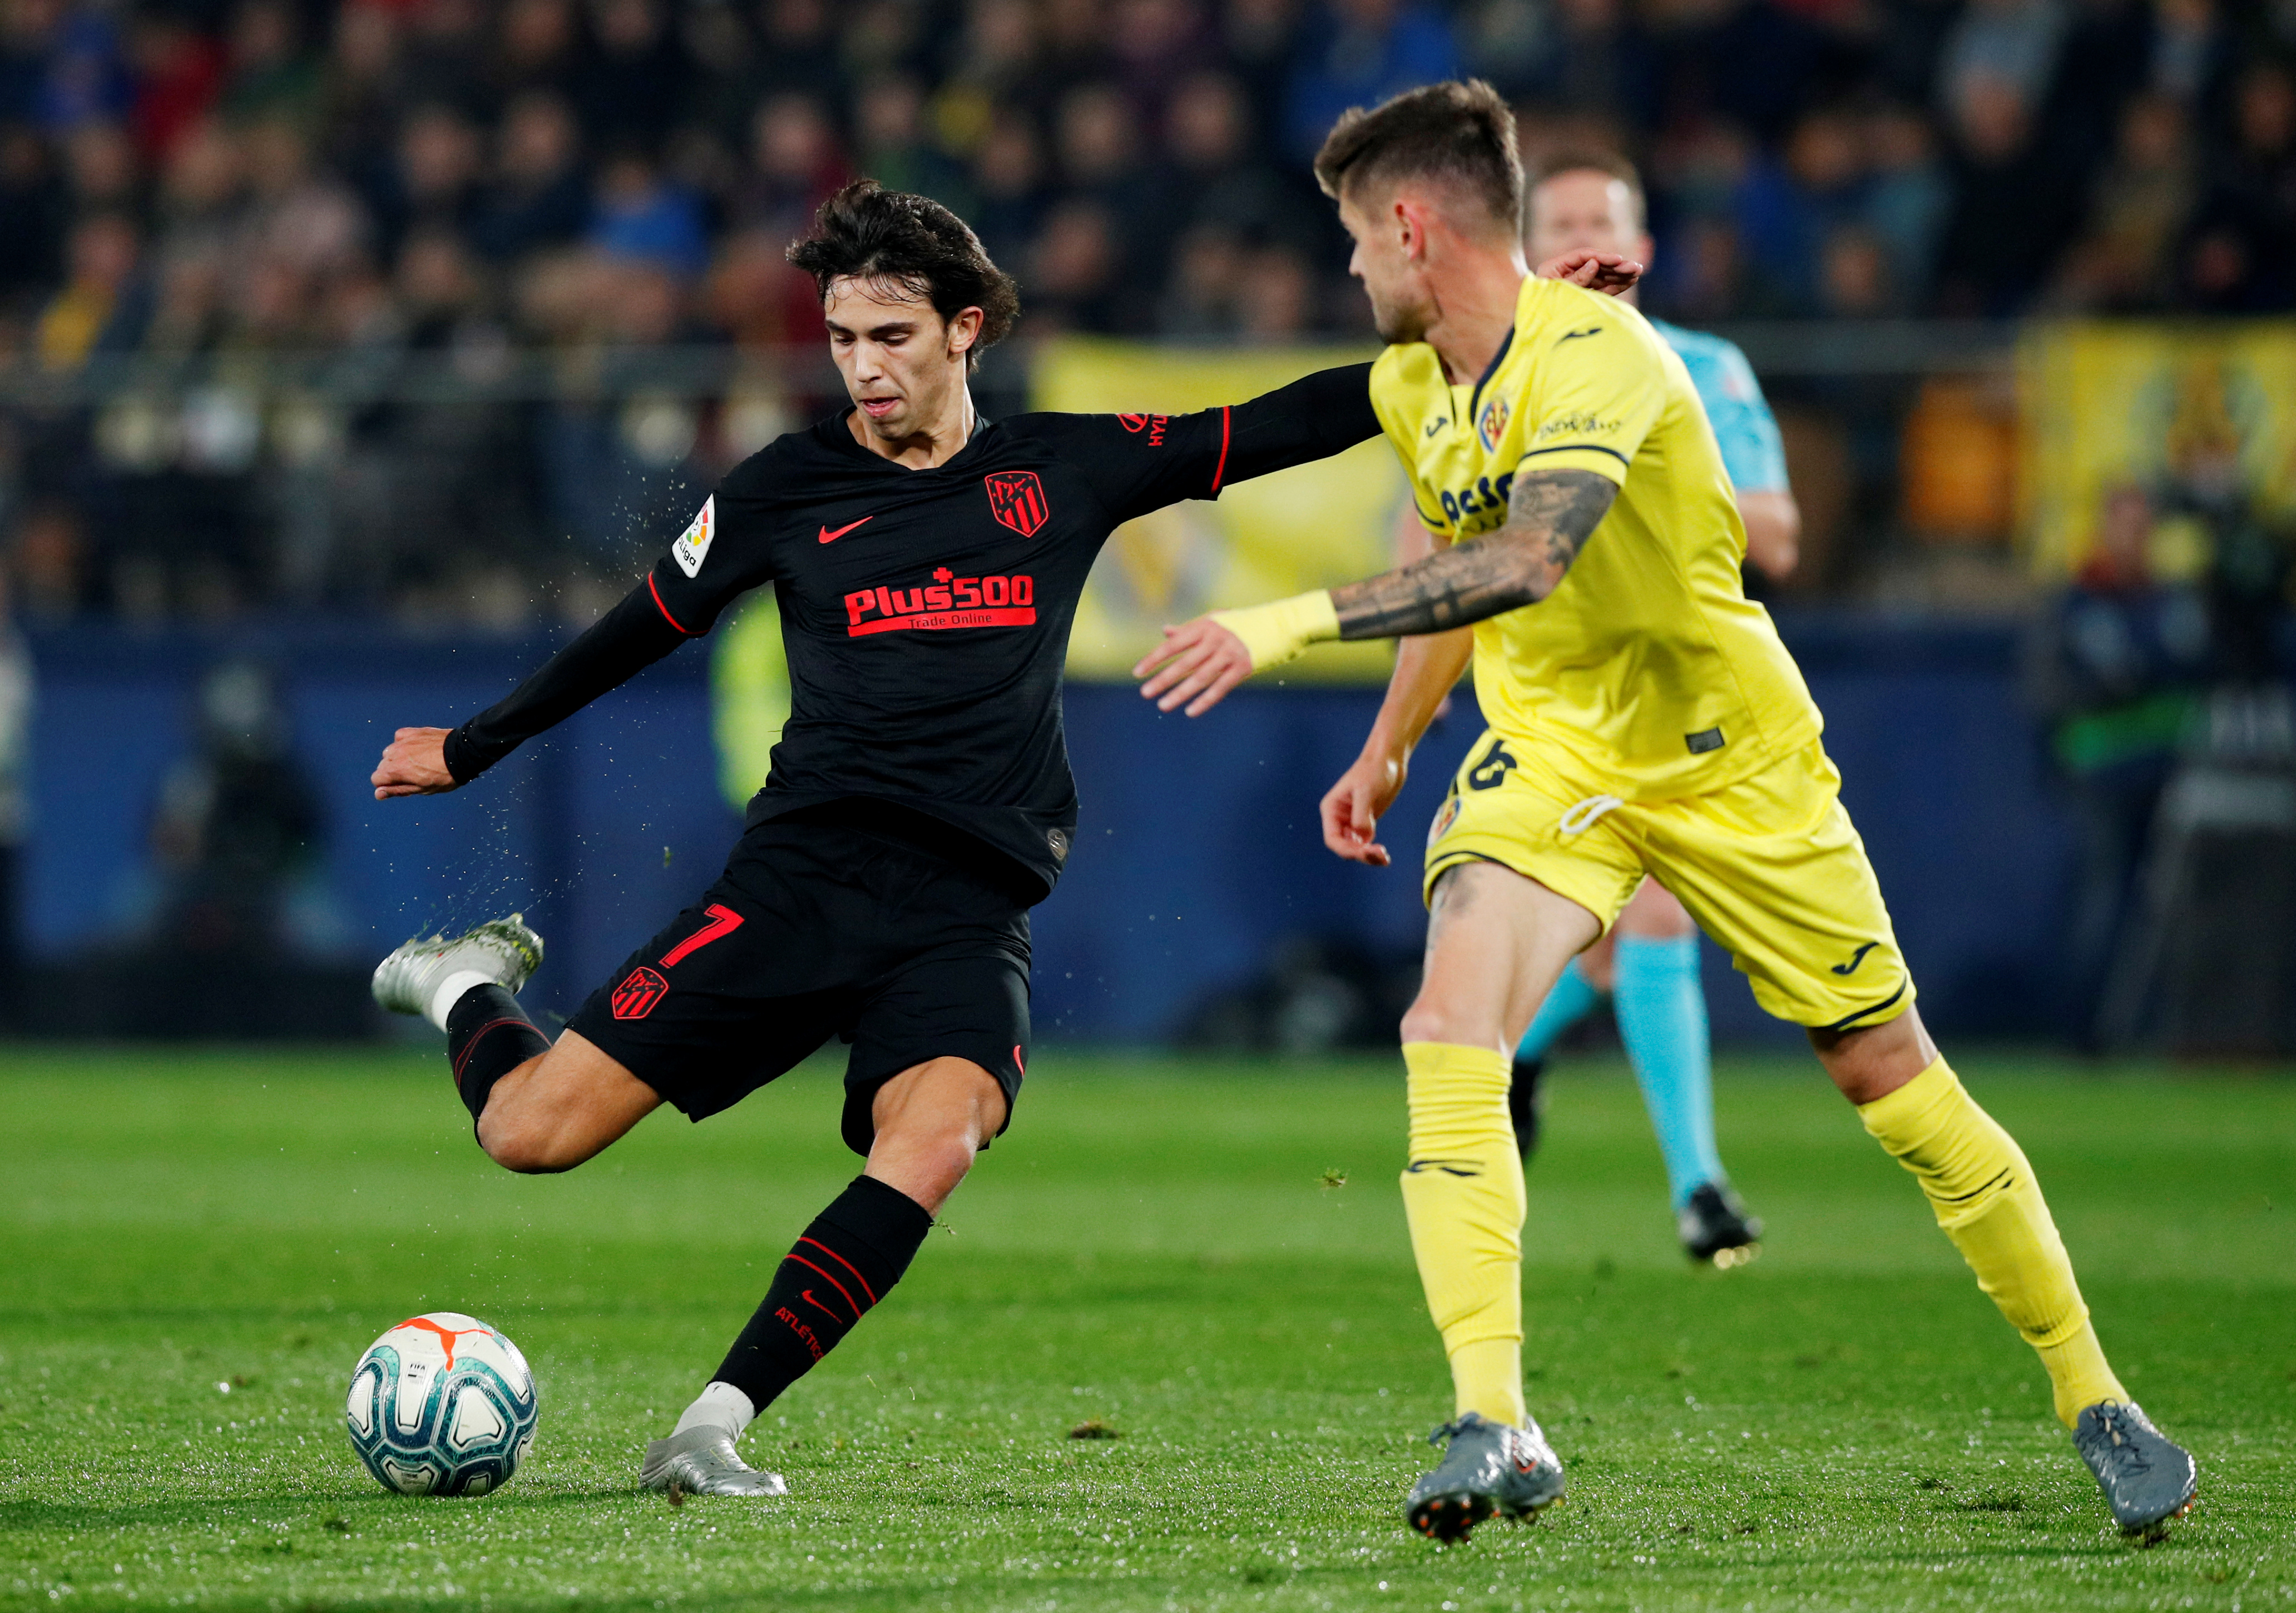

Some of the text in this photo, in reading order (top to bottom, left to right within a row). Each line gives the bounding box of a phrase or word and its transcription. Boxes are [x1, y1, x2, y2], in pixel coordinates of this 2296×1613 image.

[844, 567, 1033, 626] Plus500
[908, 613, 992, 629] Trade Online
[659, 903, 745, 968] 7
